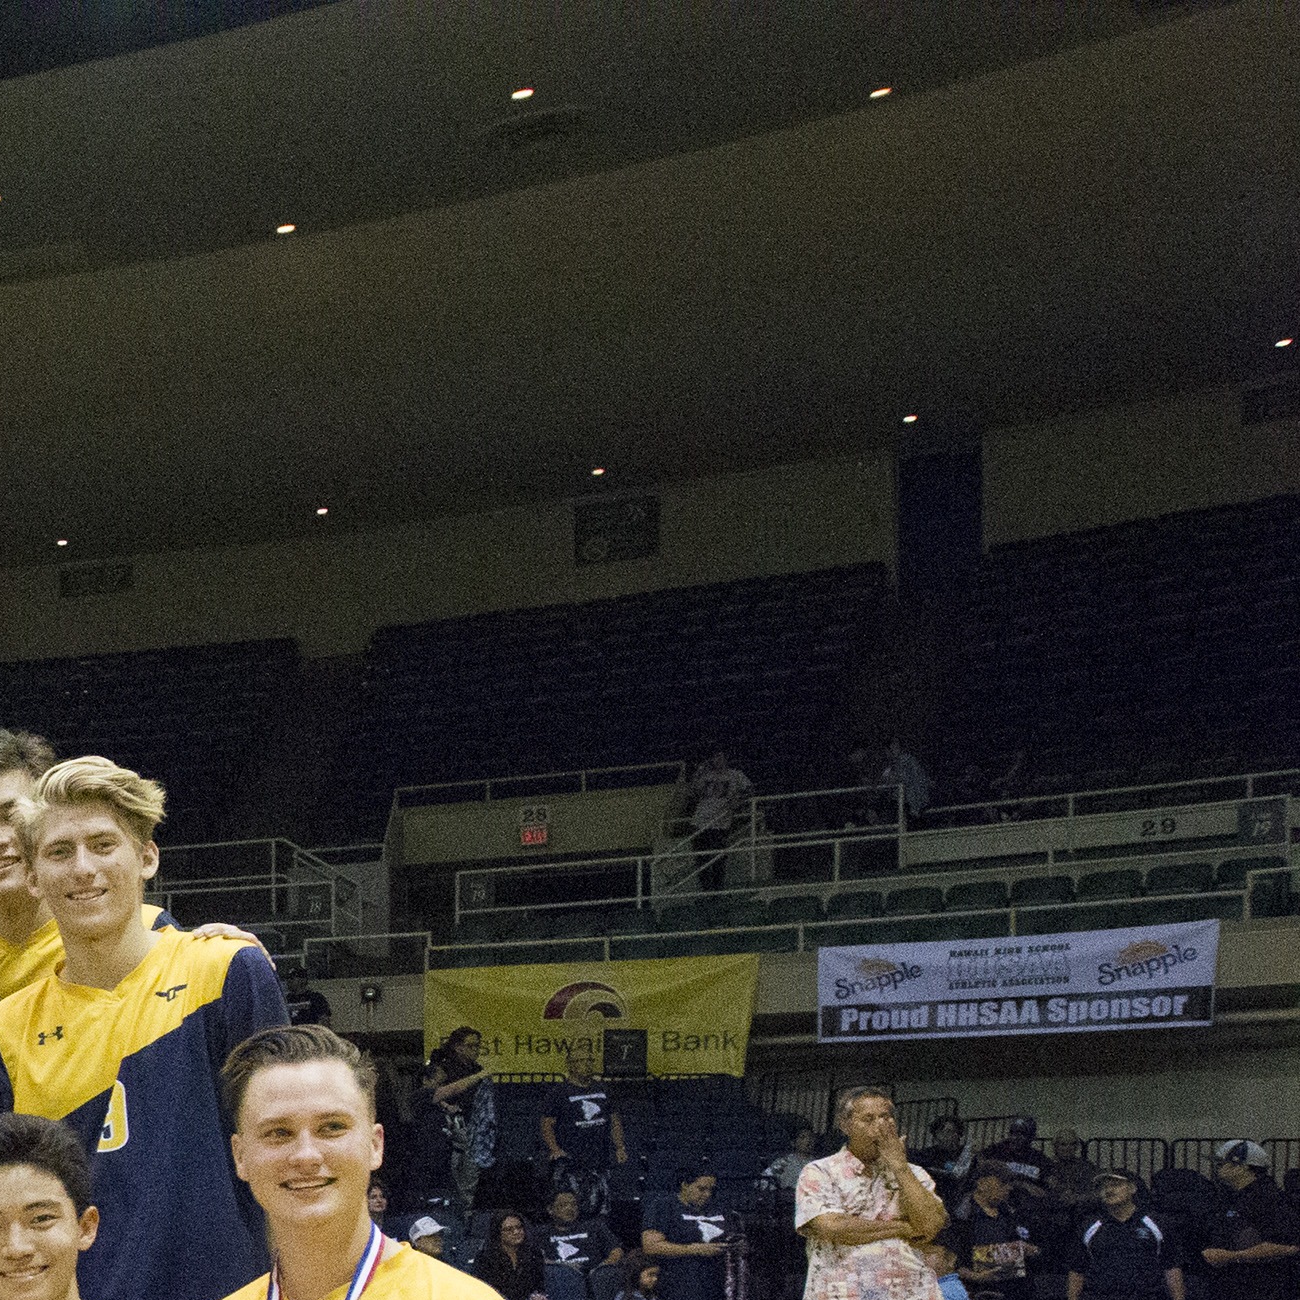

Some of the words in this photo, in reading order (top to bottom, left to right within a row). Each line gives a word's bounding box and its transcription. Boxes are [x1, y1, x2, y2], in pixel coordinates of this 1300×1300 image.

[523, 807, 548, 823] 28
[1140, 817, 1176, 838] 29
[1027, 943, 1071, 953] SCHOOL
[1097, 945, 1198, 986] Snapple
[834, 961, 924, 999] Snapple
[840, 1005, 929, 1032] Proud
[937, 1000, 1040, 1028] HHSAA
[1048, 995, 1190, 1024] Sponsor
[661, 1030, 740, 1054] Bank
